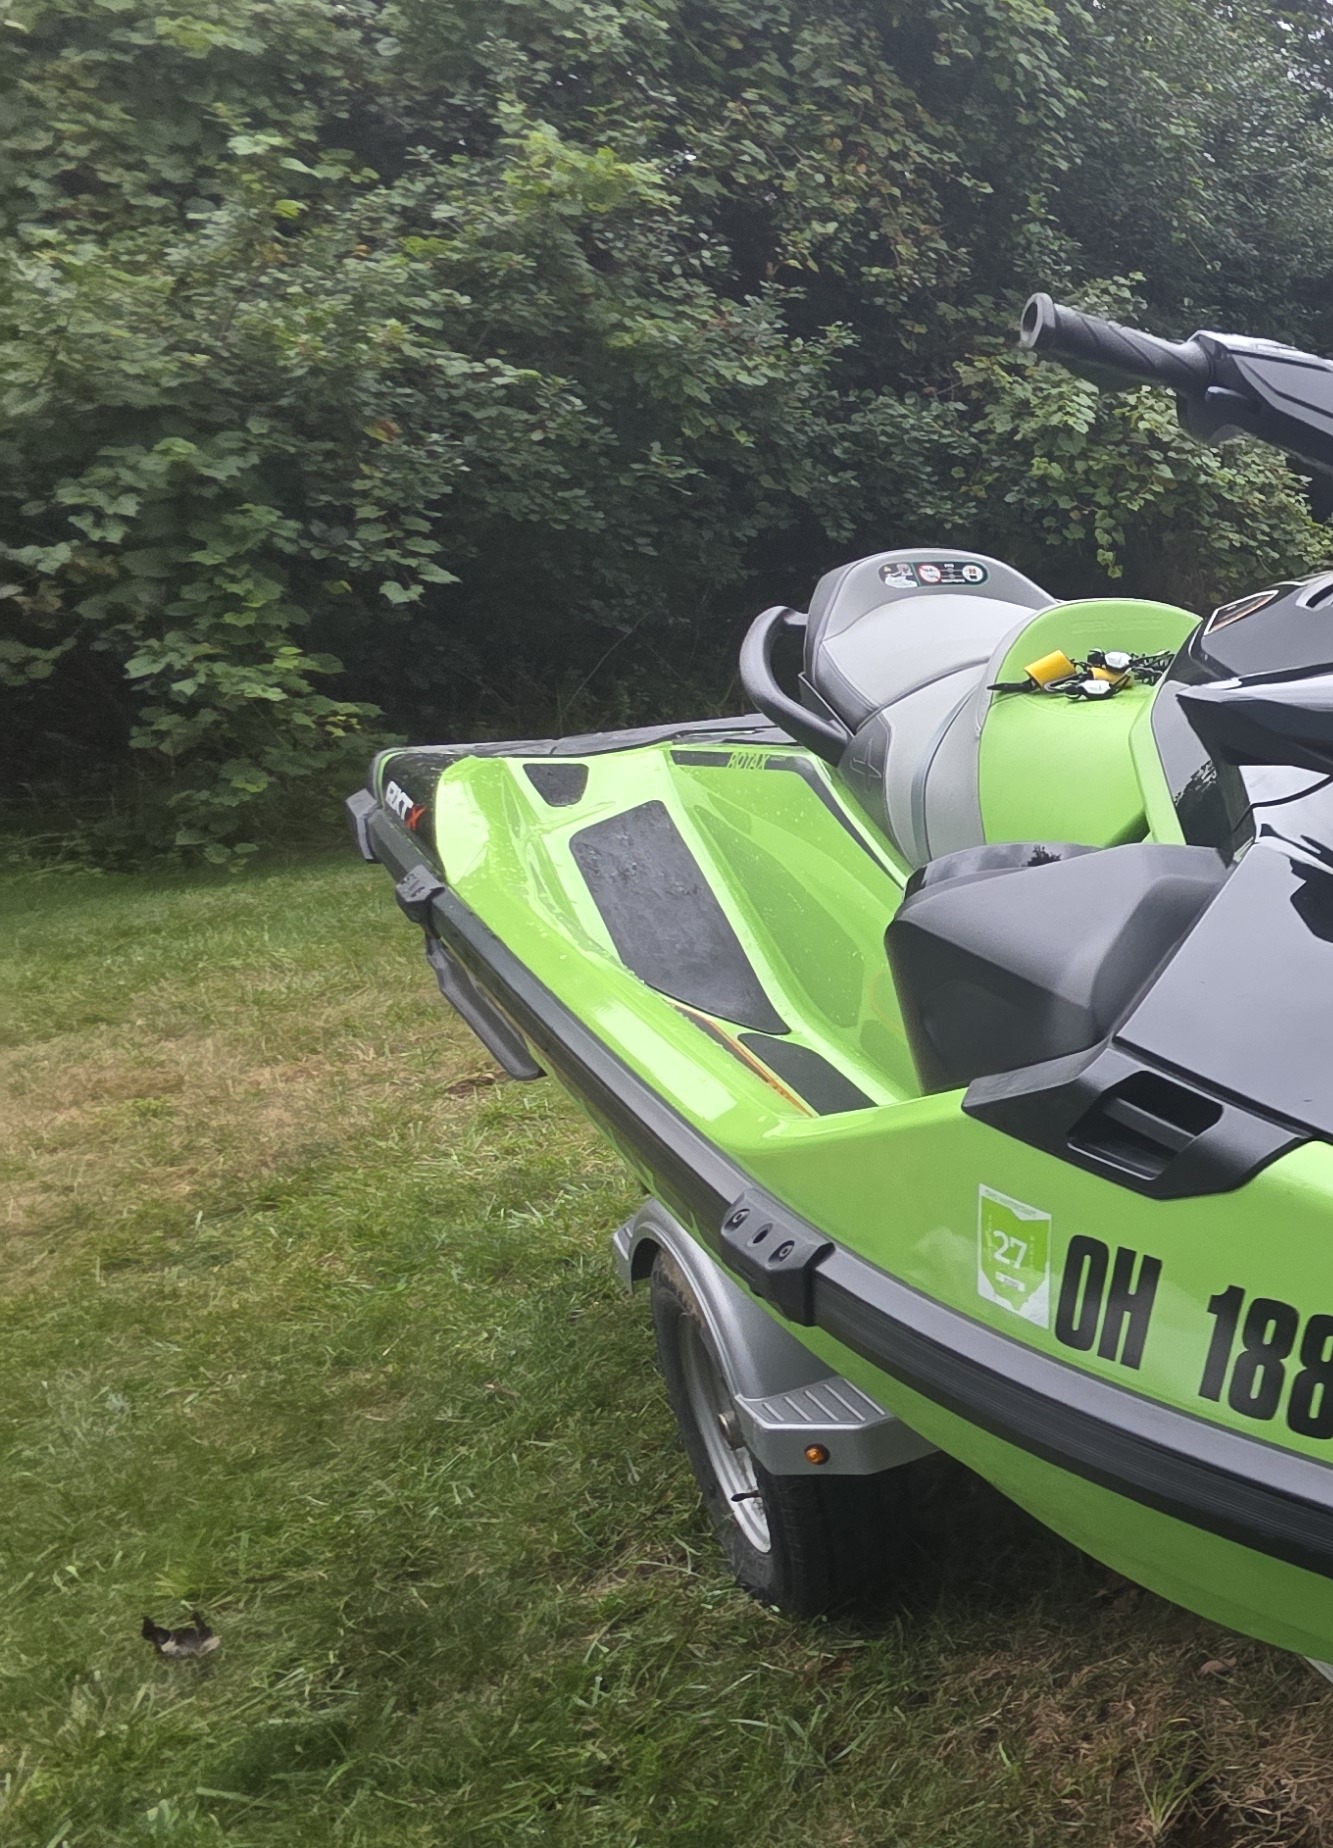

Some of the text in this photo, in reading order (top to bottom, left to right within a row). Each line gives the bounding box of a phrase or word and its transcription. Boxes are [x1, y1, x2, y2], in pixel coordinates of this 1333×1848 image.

[727, 752, 770, 770] ROTAX
[992, 1229, 1027, 1270] 27
[1054, 1234, 1163, 1370] OH
